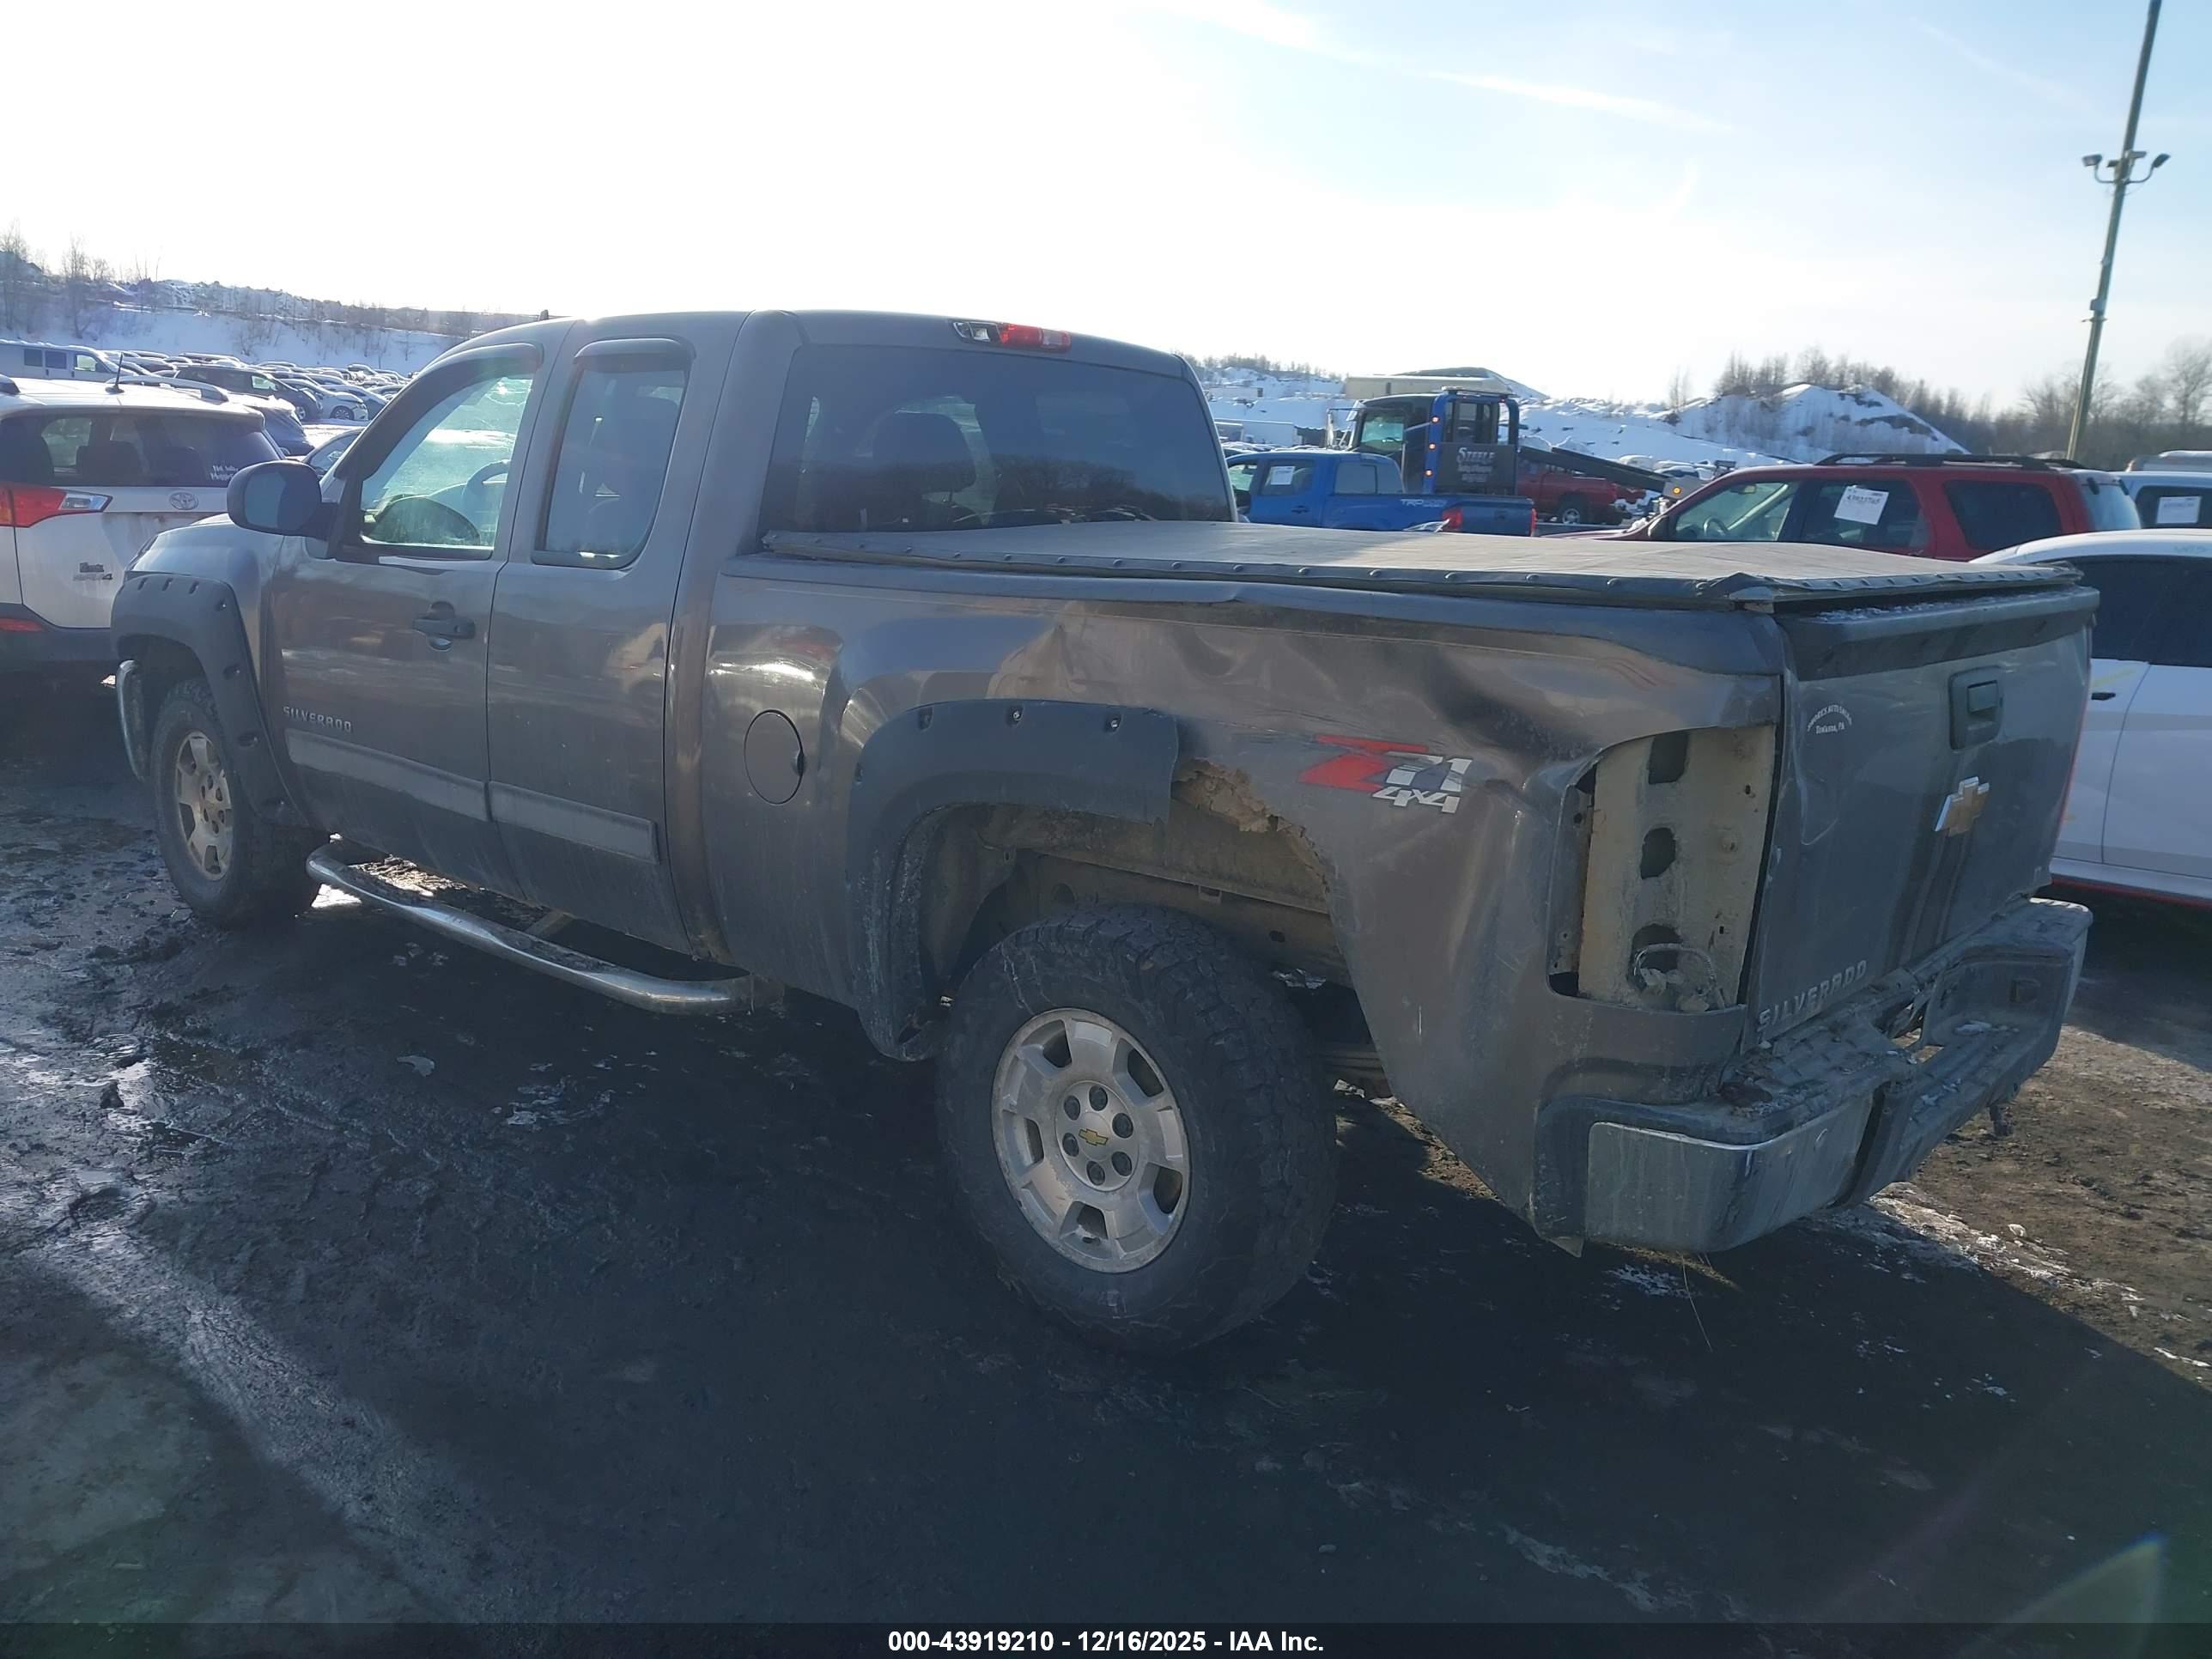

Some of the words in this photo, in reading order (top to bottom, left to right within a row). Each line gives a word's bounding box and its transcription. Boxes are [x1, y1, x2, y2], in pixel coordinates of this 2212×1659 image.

[283, 706, 352, 732] SILVERADO
[1297, 733, 1473, 793] Z71
[1757, 960, 1867, 1032] SILVERADO
